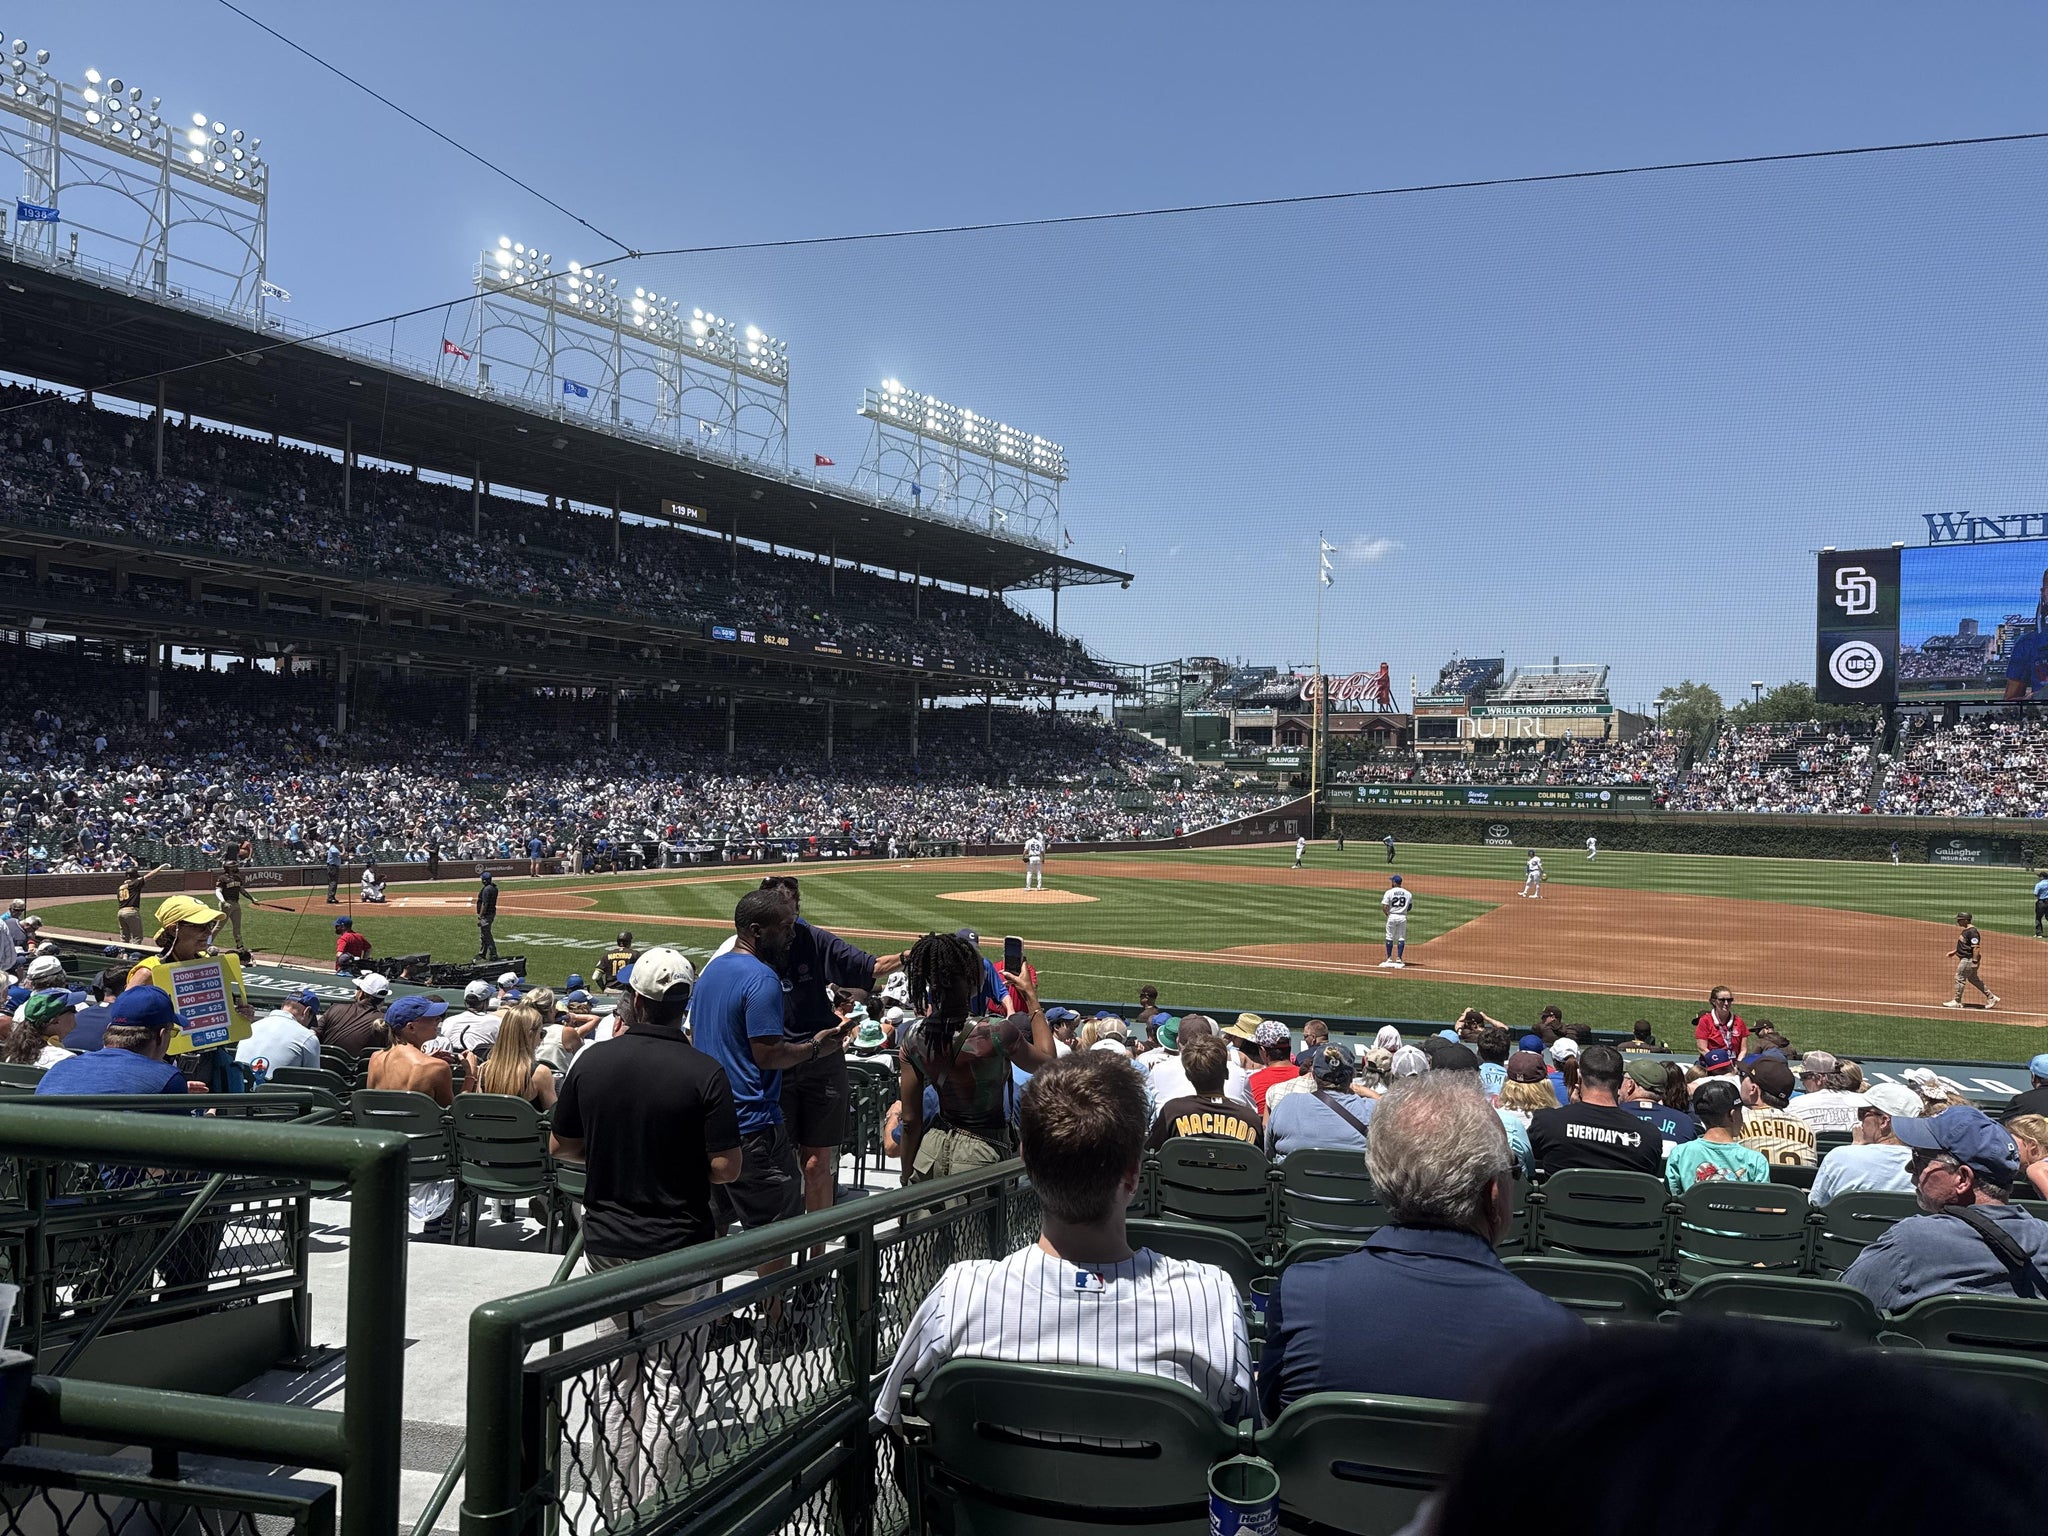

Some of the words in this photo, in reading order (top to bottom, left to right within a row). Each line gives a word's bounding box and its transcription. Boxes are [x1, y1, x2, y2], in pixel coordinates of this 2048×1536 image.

[23, 208, 47, 219] 1938
[671, 504, 686, 515] 1:19
[686, 507, 698, 519] PM
[1835, 566, 1877, 616] SD
[740, 634, 756, 644] TOTAL
[763, 634, 789, 647] $62,408
[1105, 683, 1118, 691] FIELD
[1487, 706, 1597, 715] WRIGLEYROOFTOPS.COM
[1327, 789, 1353, 798] Harvey
[1284, 820, 1299, 834] YETI
[1934, 848, 1981, 857] Gallagher
[245, 871, 284, 882] MARQUEE
[1391, 896, 1406, 908] 29
[968, 932, 976, 940] C
[175, 972, 194, 980] 2000
[200, 968, 219, 977] $200
[179, 984, 194, 993] 300
[201, 980, 220, 989] $100
[182, 996, 196, 1004] 100
[206, 991, 220, 1000] $50
[185, 1008, 196, 1016] 25
[208, 1003, 223, 1012] $25
[211, 1015, 225, 1023] $10
[1175, 1113, 1257, 1145] MACHADO
[1657, 1118, 1676, 1136] JR.
[1566, 1123, 1620, 1144] EVERYDAY
[1740, 1120, 1814, 1149] MACHADO
[1241, 1511, 1271, 1523] Hefty
